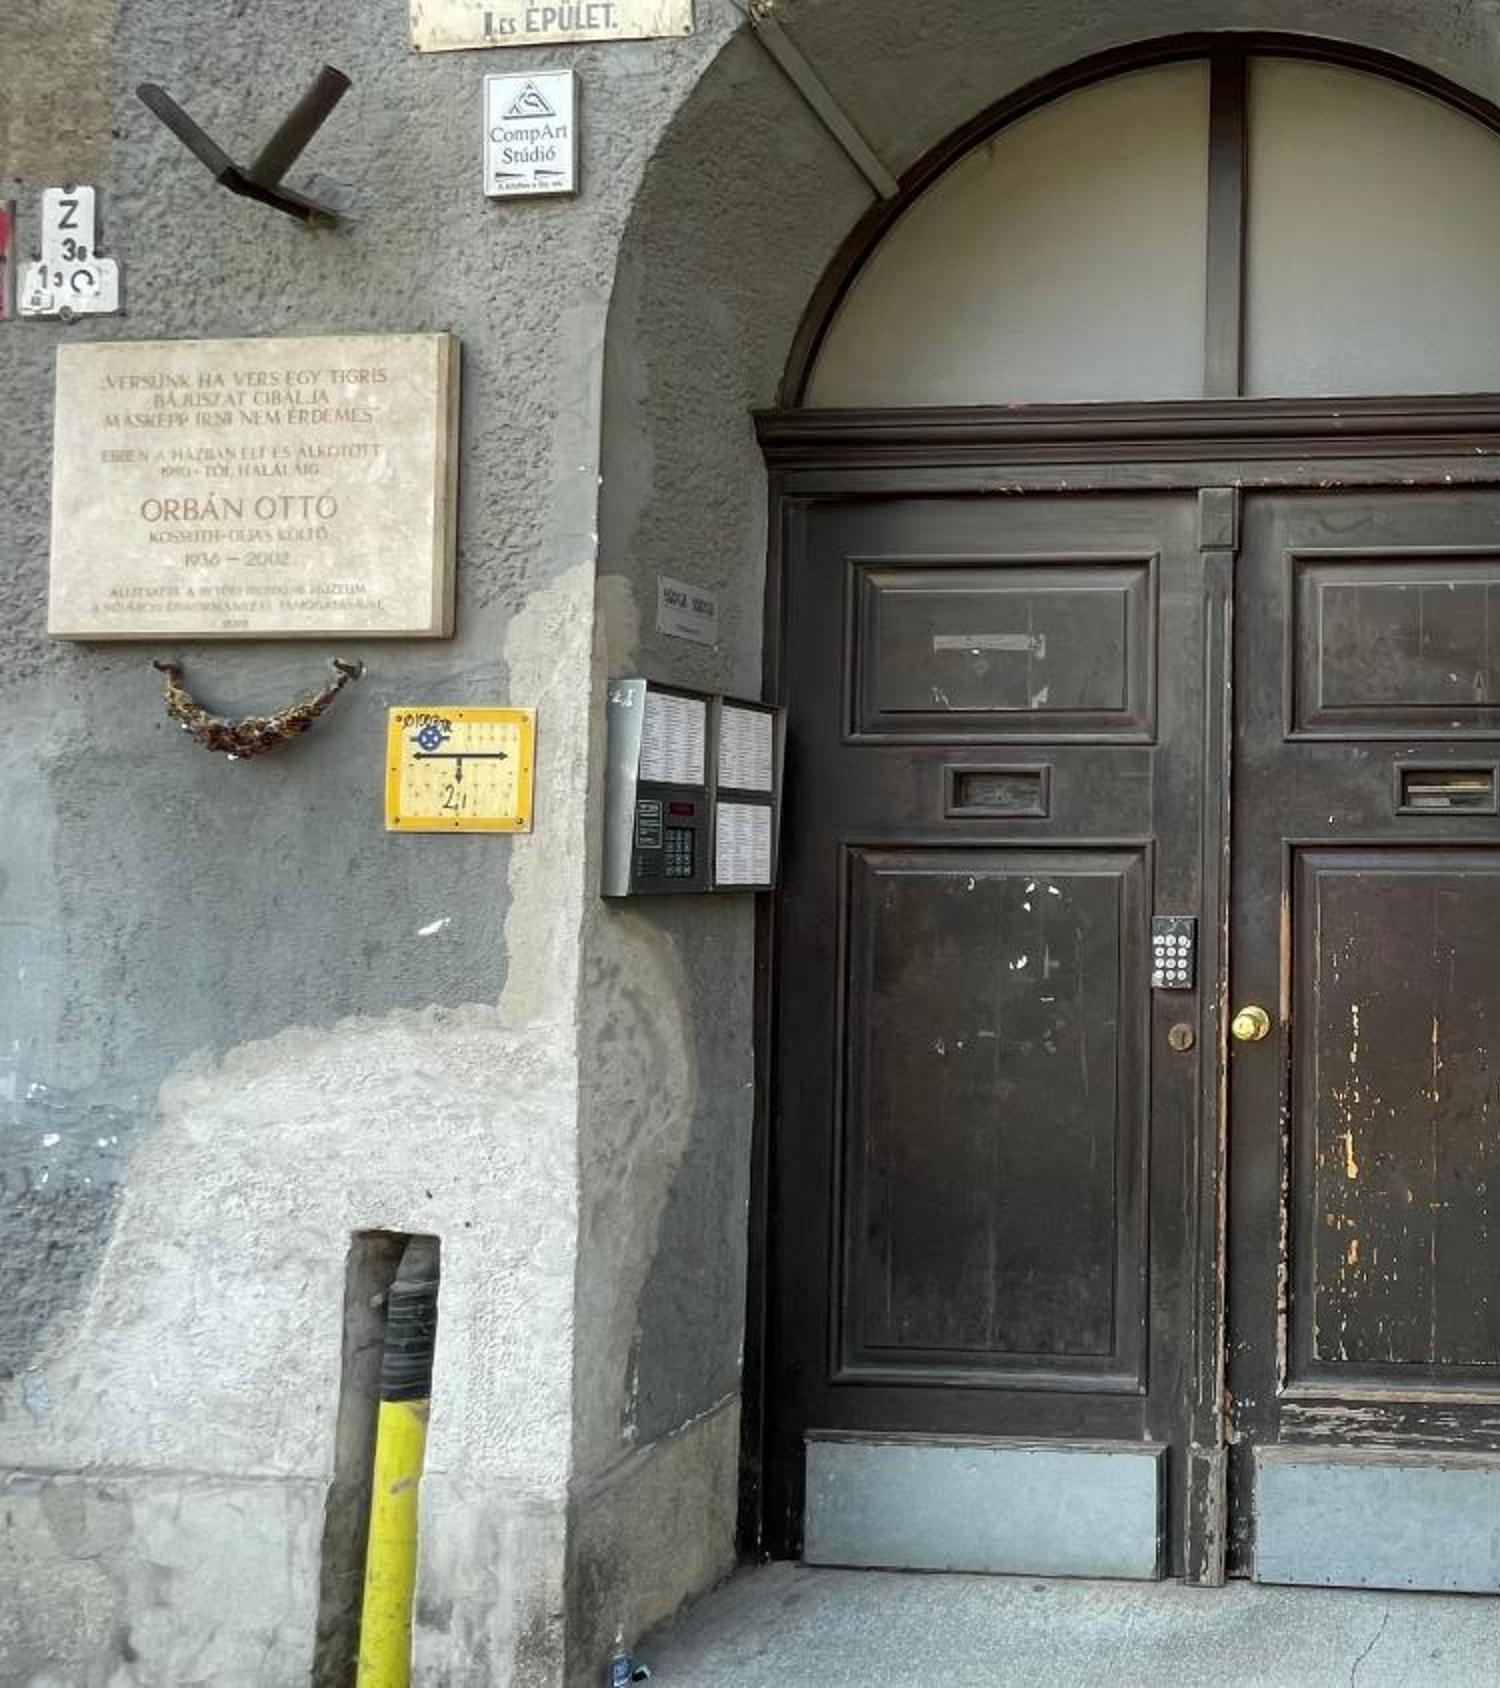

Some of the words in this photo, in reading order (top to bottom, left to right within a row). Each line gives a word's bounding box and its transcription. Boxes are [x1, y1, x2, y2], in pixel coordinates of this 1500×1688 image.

[490, 124, 567, 144] CompArt
[502, 145, 556, 164] Stúdió
[58, 199, 78, 229] Z
[199, 372, 225, 388] HA
[233, 370, 280, 387] VERS
[285, 369, 321, 386] EGY
[330, 367, 388, 385] TIGRIS
[239, 409, 281, 426] NEM
[141, 491, 244, 522] ORBÁN
[254, 488, 338, 520] OTTÓ
